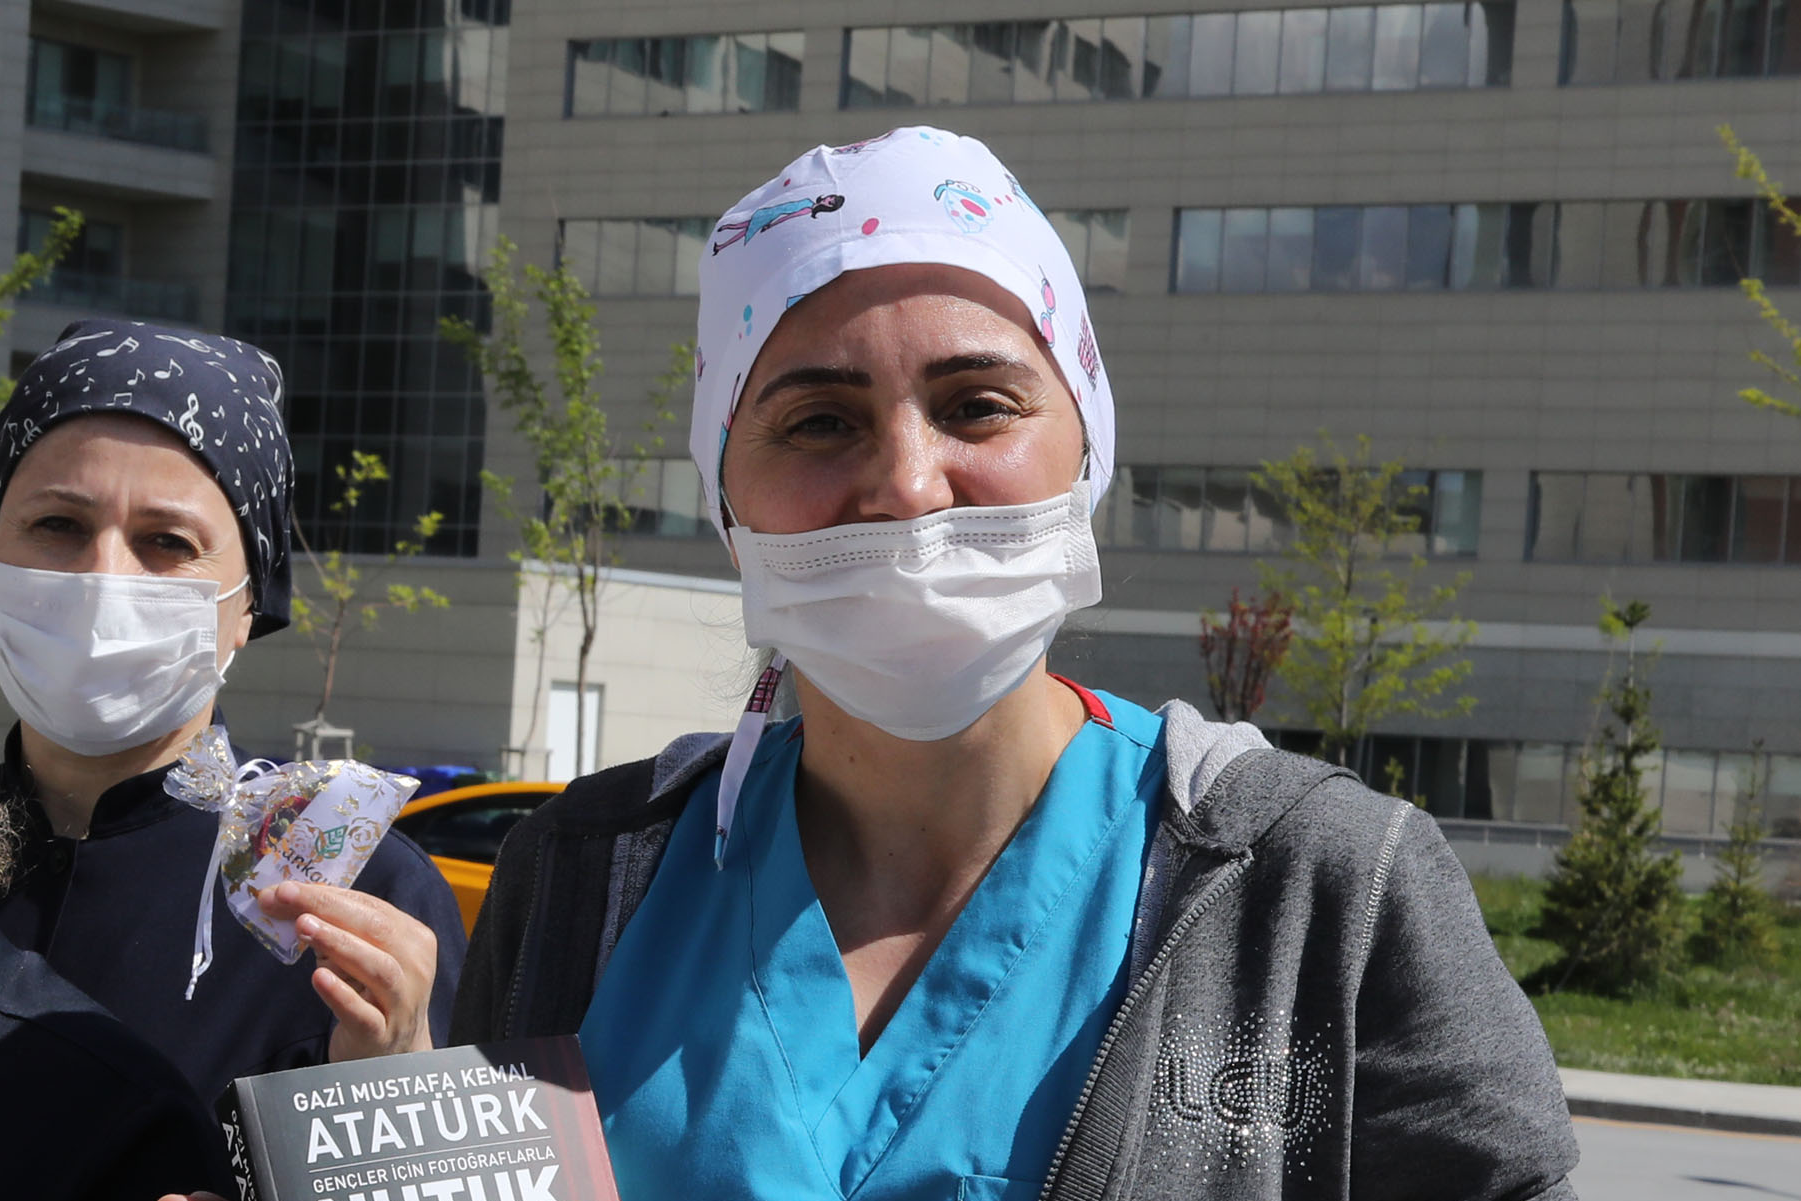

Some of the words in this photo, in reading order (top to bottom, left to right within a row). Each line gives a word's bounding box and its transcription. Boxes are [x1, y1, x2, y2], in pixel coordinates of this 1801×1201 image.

[293, 1081, 345, 1113] GAZİ
[350, 1071, 457, 1104] MUSTAFA
[460, 1062, 536, 1088] KEMAL
[307, 1087, 548, 1165] ATATÜRK
[313, 1169, 389, 1194] GENÇLER
[392, 1162, 425, 1183] İÇİN
[428, 1145, 556, 1175] FOTOĞRAFLARLA
